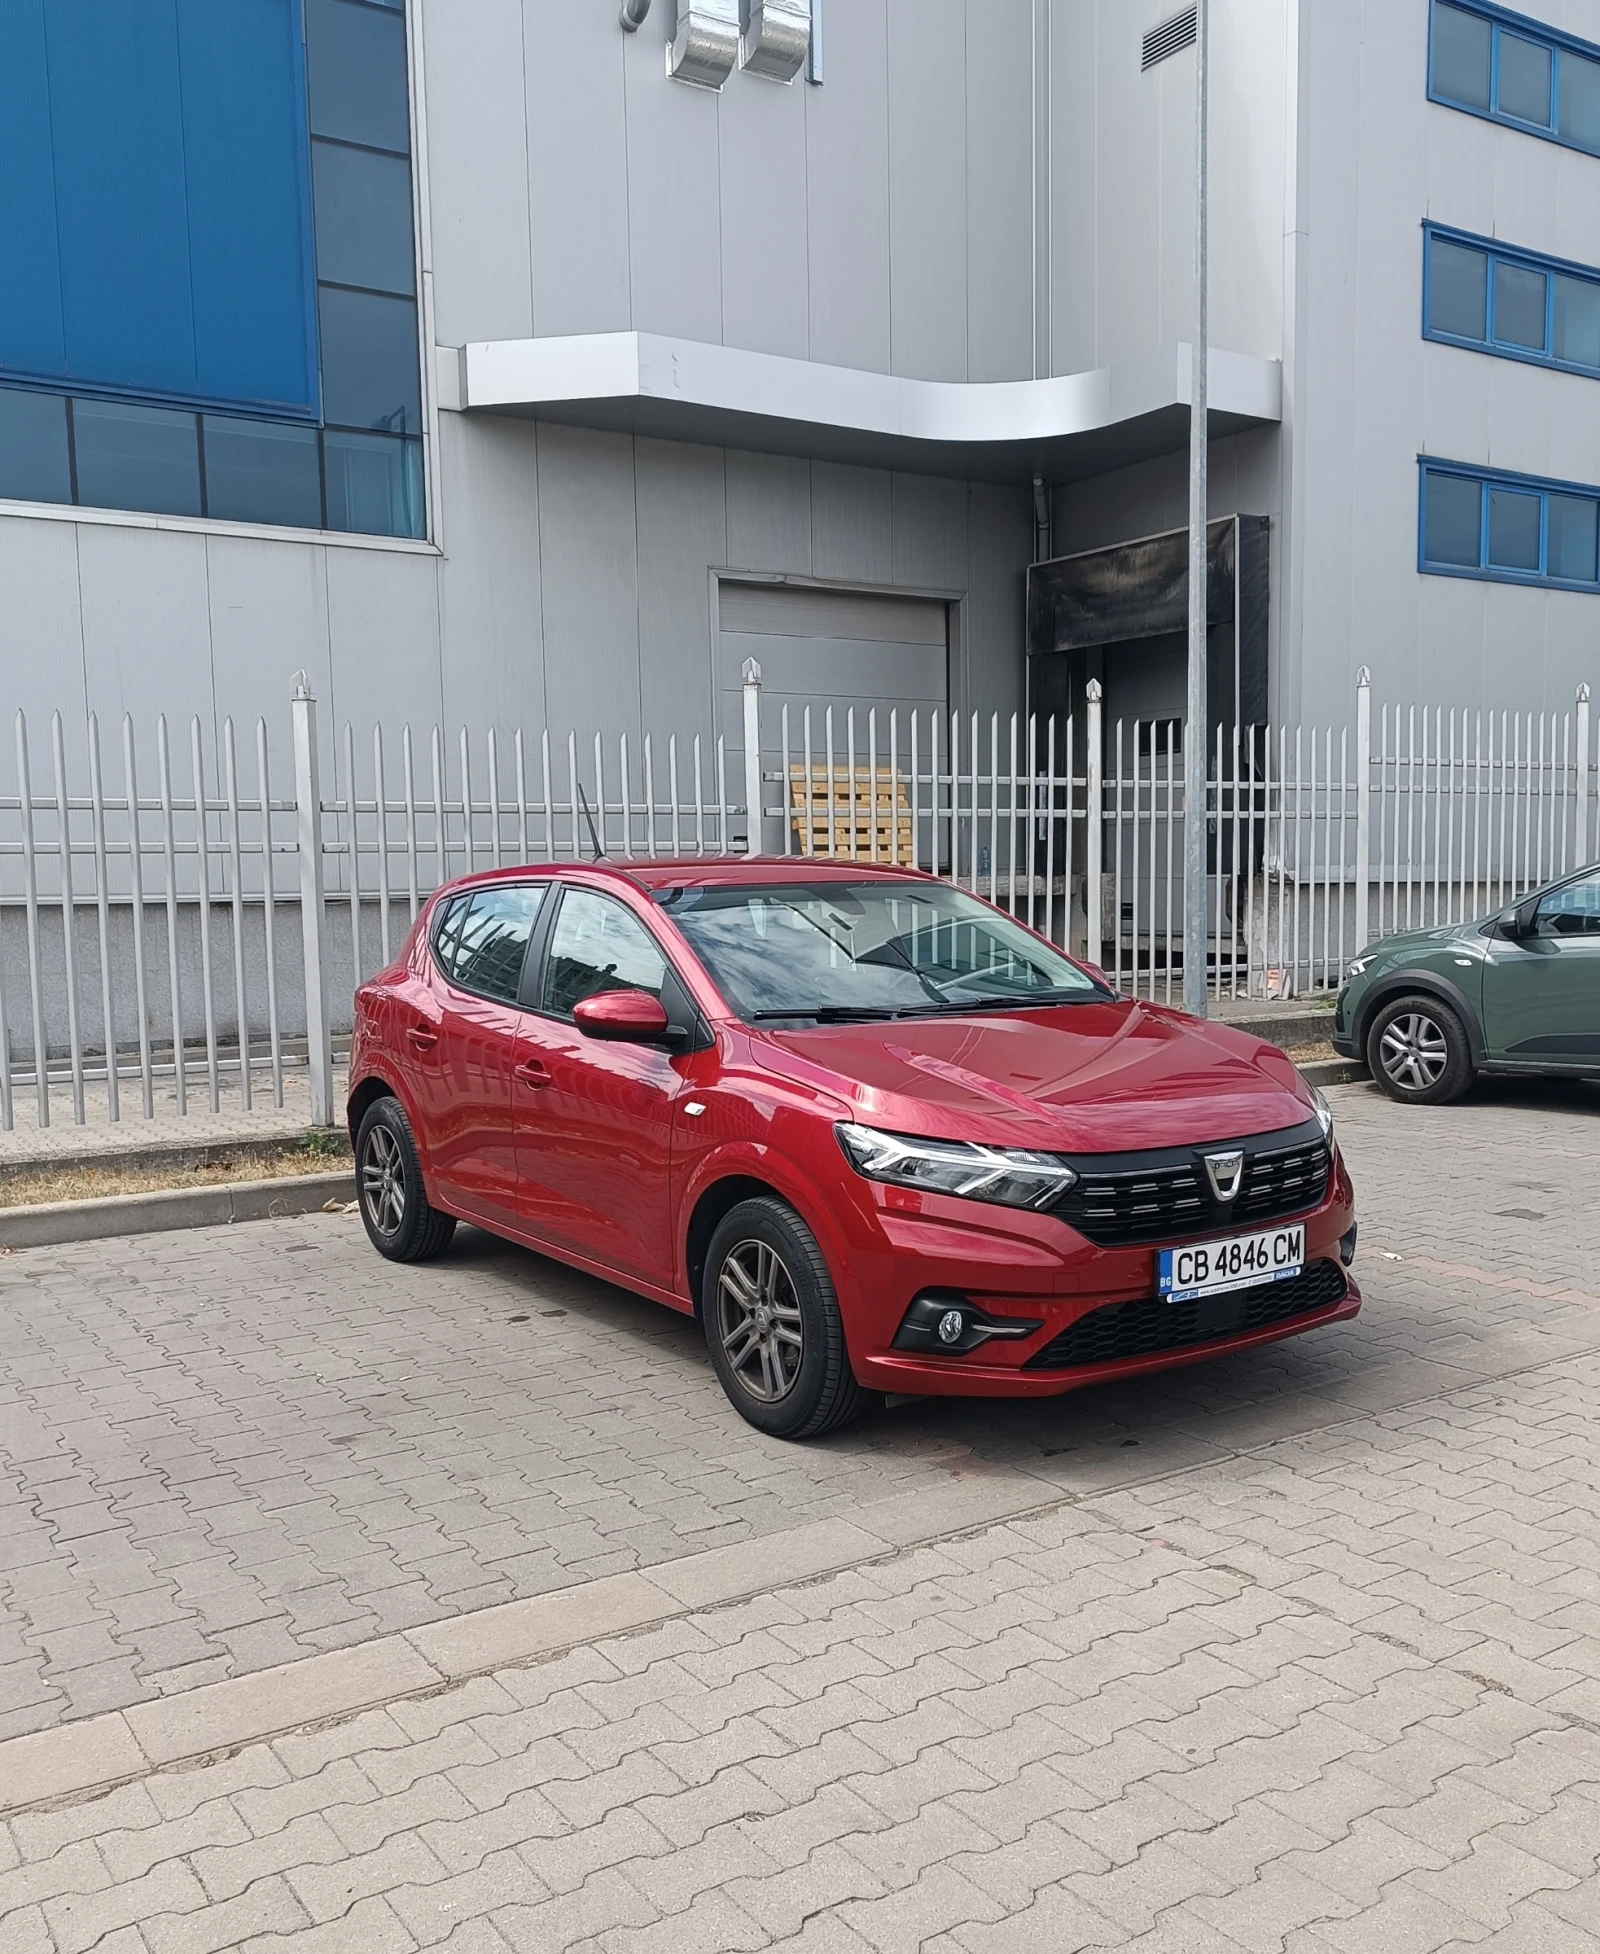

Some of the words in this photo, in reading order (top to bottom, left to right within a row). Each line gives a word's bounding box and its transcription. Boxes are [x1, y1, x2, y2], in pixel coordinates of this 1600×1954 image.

[1177, 1250, 1209, 1285] CB
[1214, 1237, 1269, 1277] 4846
[1273, 1230, 1301, 1265] CM
[1276, 1269, 1295, 1279] DACIA
[1160, 1276, 1171, 1288] BG
